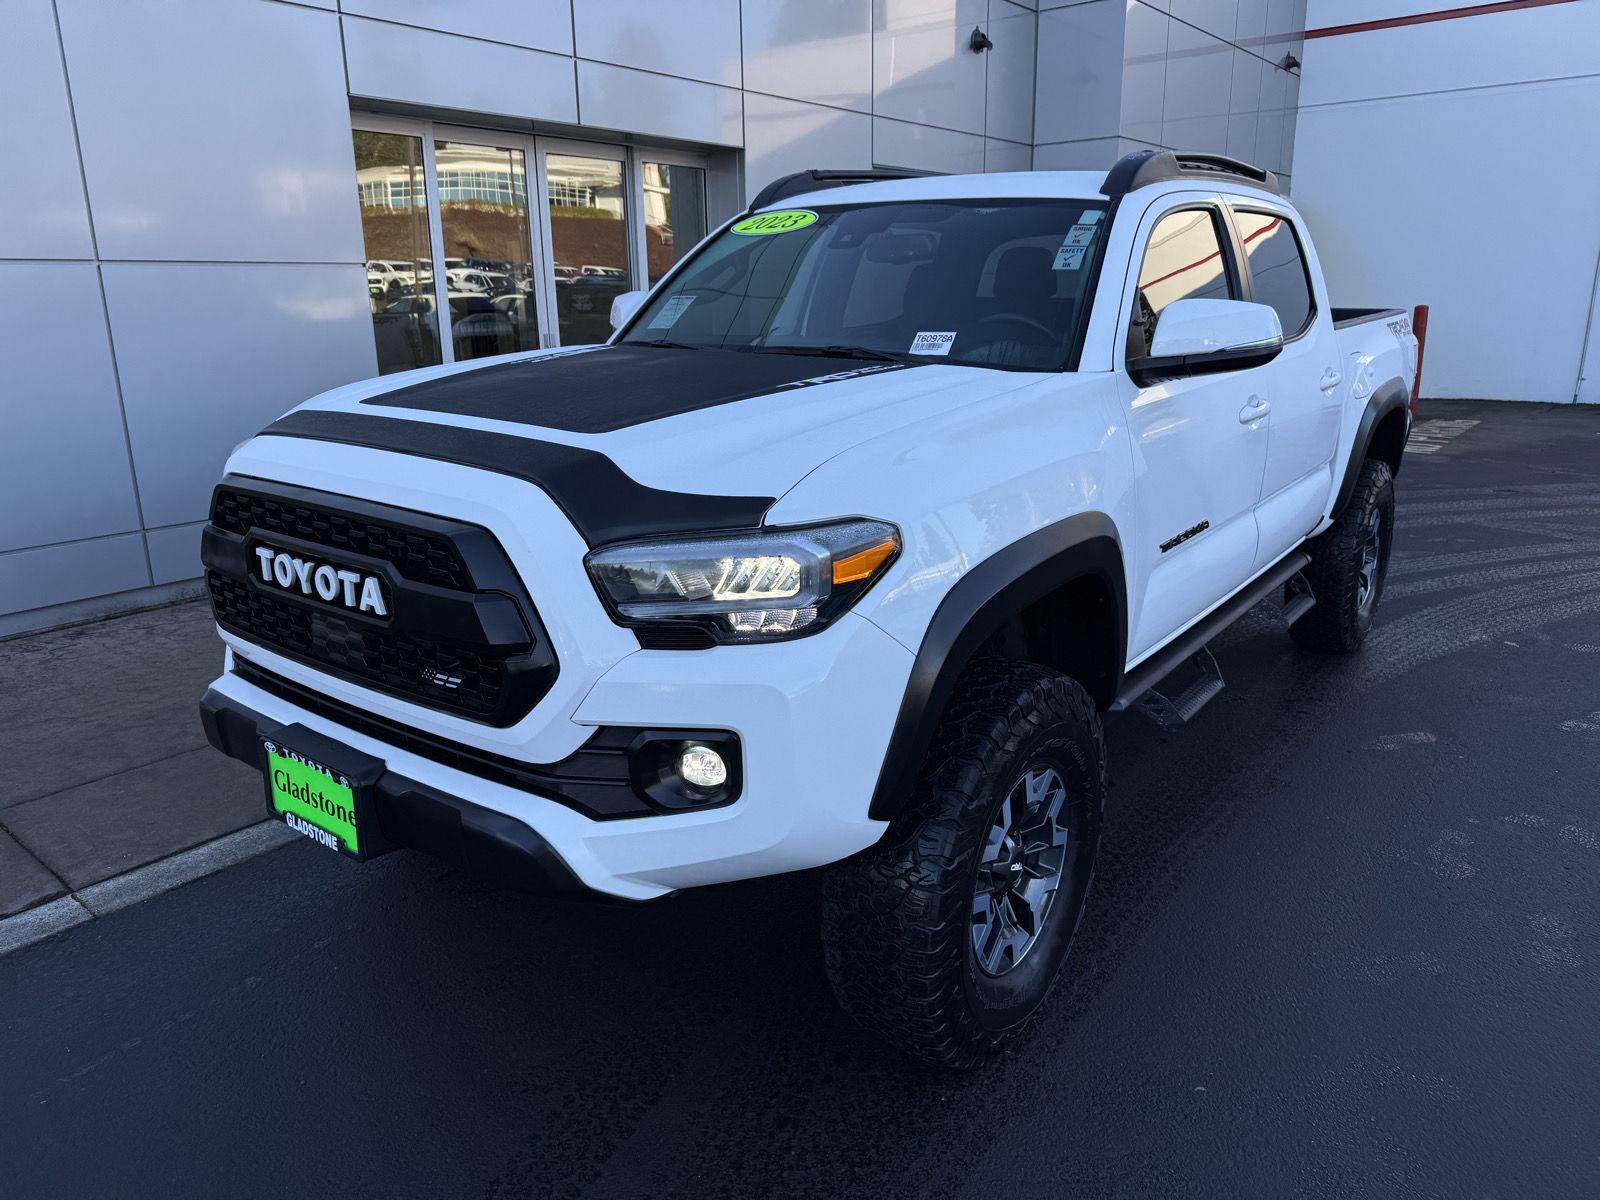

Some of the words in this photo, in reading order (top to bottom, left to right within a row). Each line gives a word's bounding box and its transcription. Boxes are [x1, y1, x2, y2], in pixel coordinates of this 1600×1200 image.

[740, 214, 807, 231] 2023
[255, 546, 388, 616] TOYOTA
[283, 748, 334, 779] TOYOTA
[273, 769, 357, 828] Gladstone
[286, 812, 339, 852] GLADSTONE
